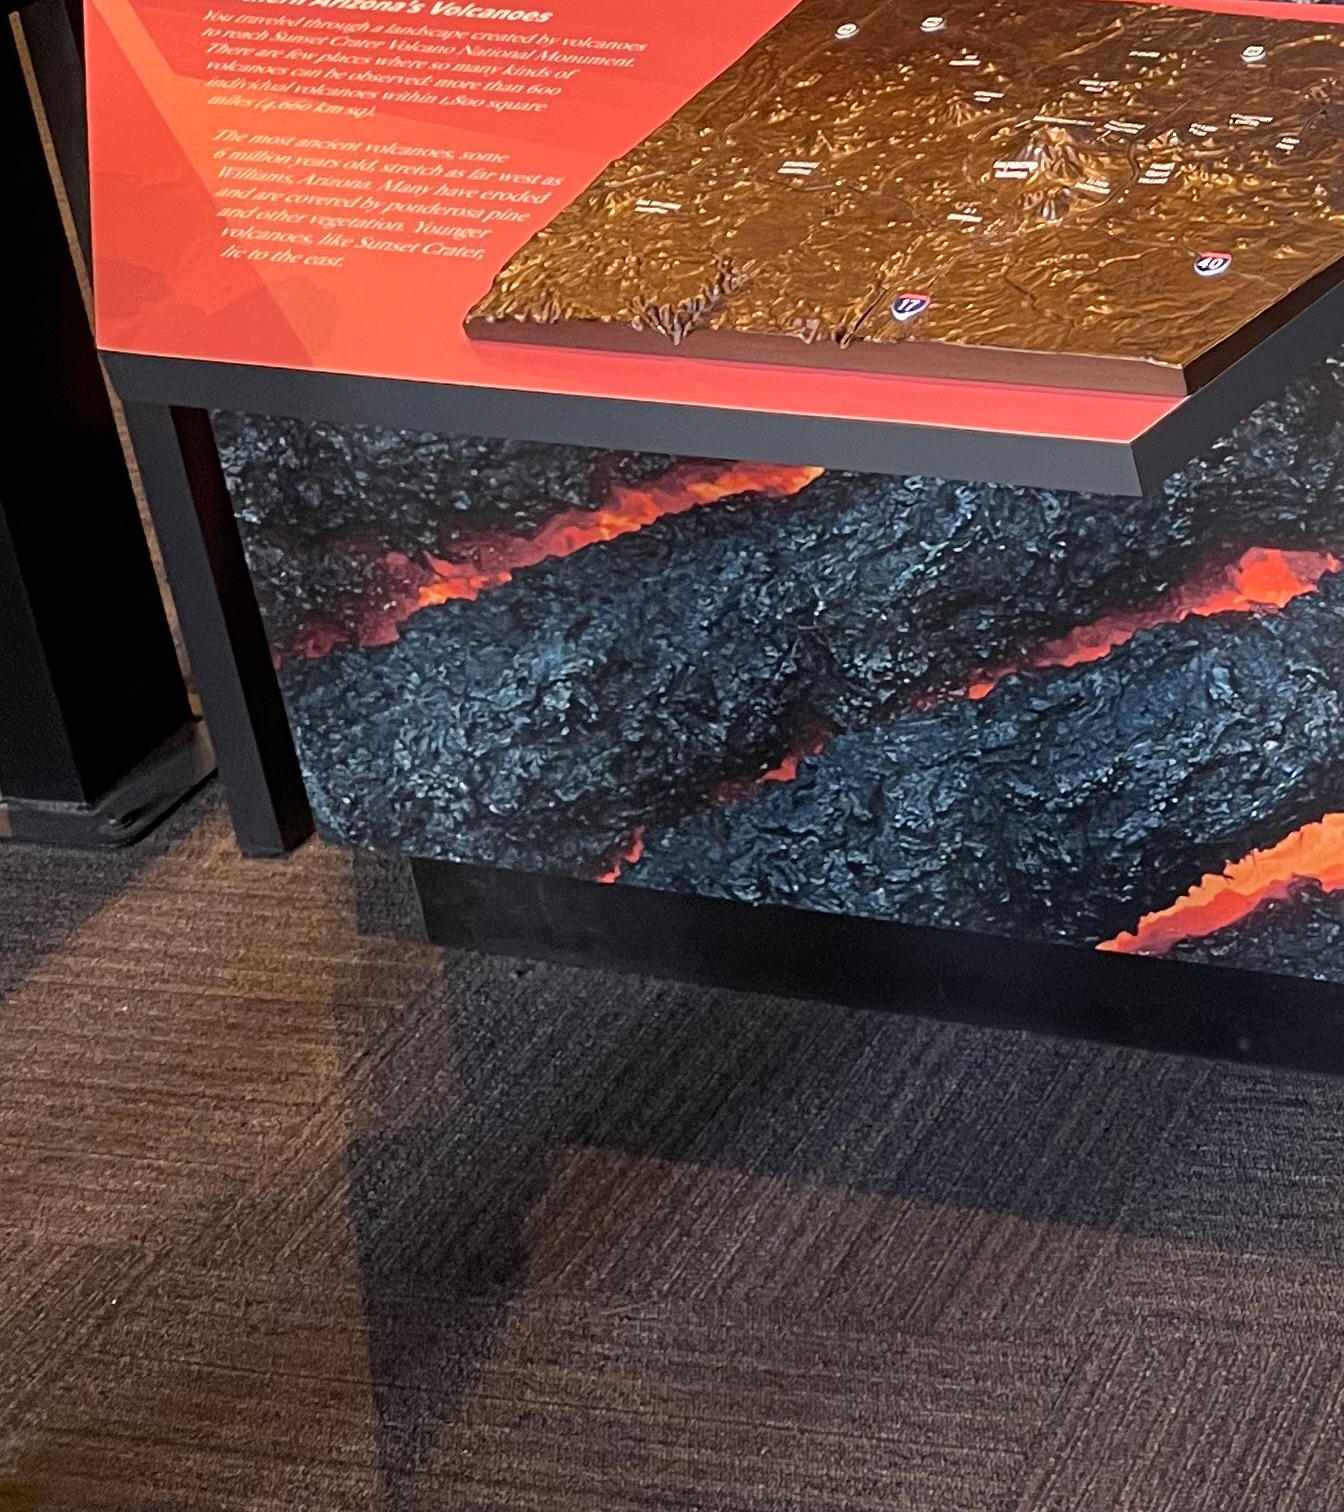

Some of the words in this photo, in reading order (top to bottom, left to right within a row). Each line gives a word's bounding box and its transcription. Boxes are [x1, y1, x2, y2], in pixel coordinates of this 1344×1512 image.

[430, 2, 553, 22] Volcanoes
[201, 28, 221, 37] to
[222, 30, 270, 40] reach
[269, 32, 329, 44] Sunset
[329, 36, 385, 48] Crater
[389, 40, 455, 54] Volcano
[456, 45, 537, 59] National
[534, 50, 635, 67] Monument.
[221, 226, 313, 244] volcanoes,
[317, 233, 354, 247] like
[354, 237, 421, 253] Sunset
[421, 242, 485, 260] Crater,
[220, 245, 247, 258] lie
[247, 250, 269, 260] to
[270, 249, 303, 263] the
[304, 256, 344, 267] east.
[1197, 257, 1225, 271] 40
[896, 298, 920, 313] 17
